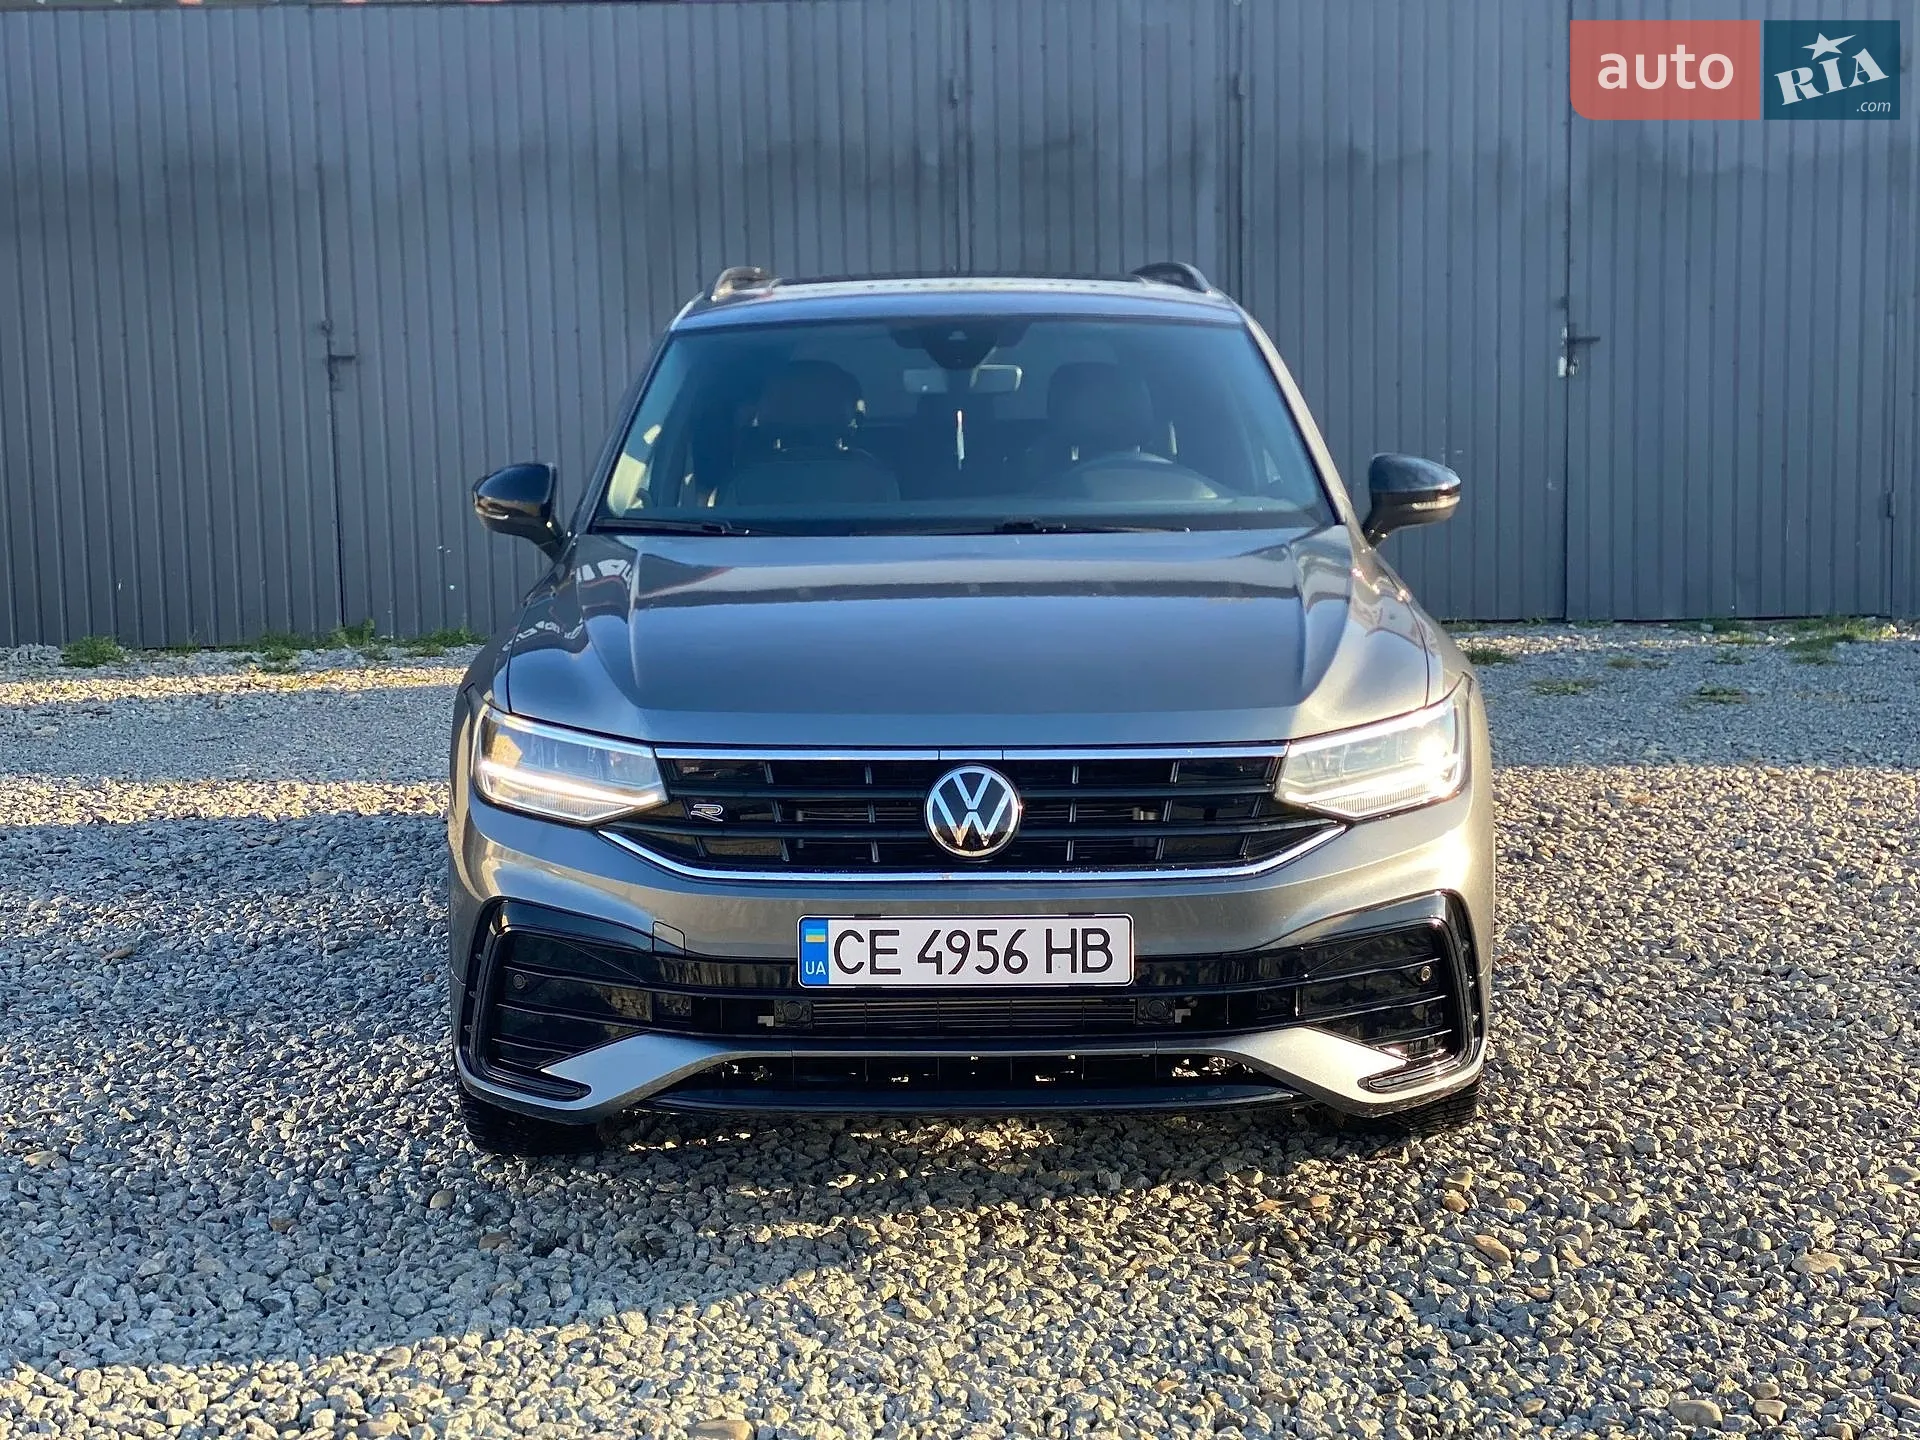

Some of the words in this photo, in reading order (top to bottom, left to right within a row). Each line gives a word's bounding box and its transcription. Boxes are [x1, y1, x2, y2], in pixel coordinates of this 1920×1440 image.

[690, 803, 725, 822] R
[833, 929, 902, 975] CE
[917, 929, 1029, 975] 4956
[1045, 928, 1114, 974] HB
[805, 960, 827, 975] UA
